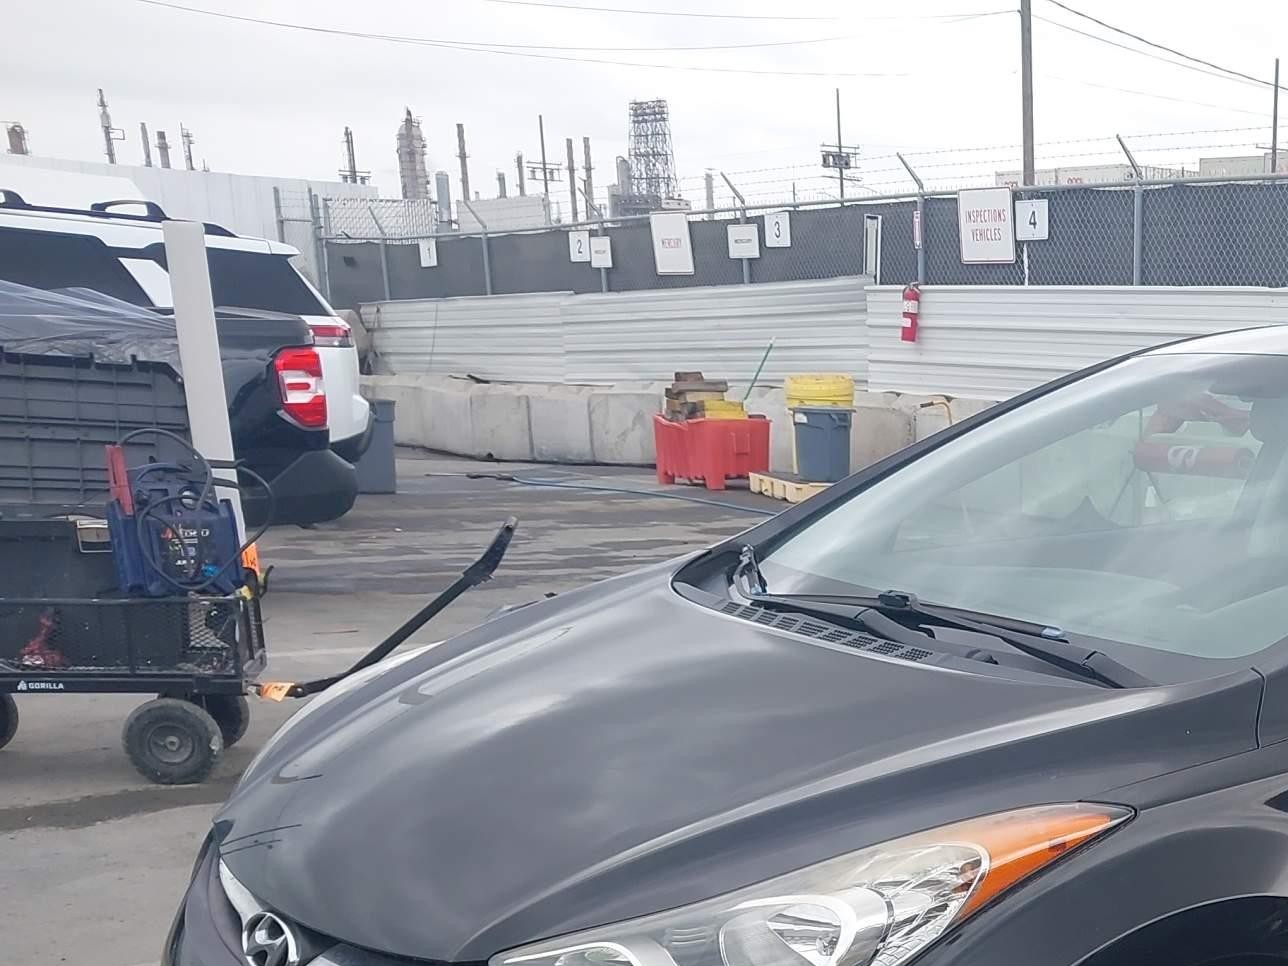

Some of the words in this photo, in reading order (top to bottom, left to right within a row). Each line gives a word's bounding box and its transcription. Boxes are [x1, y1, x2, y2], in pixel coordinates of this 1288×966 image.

[965, 208, 1007, 224] INSPECTIONS
[1028, 210, 1038, 230] 4
[774, 220, 781, 239] 3
[970, 228, 1002, 242] VEHICLES
[576, 239, 583, 254] 2
[28, 682, 64, 690] GORILLA
